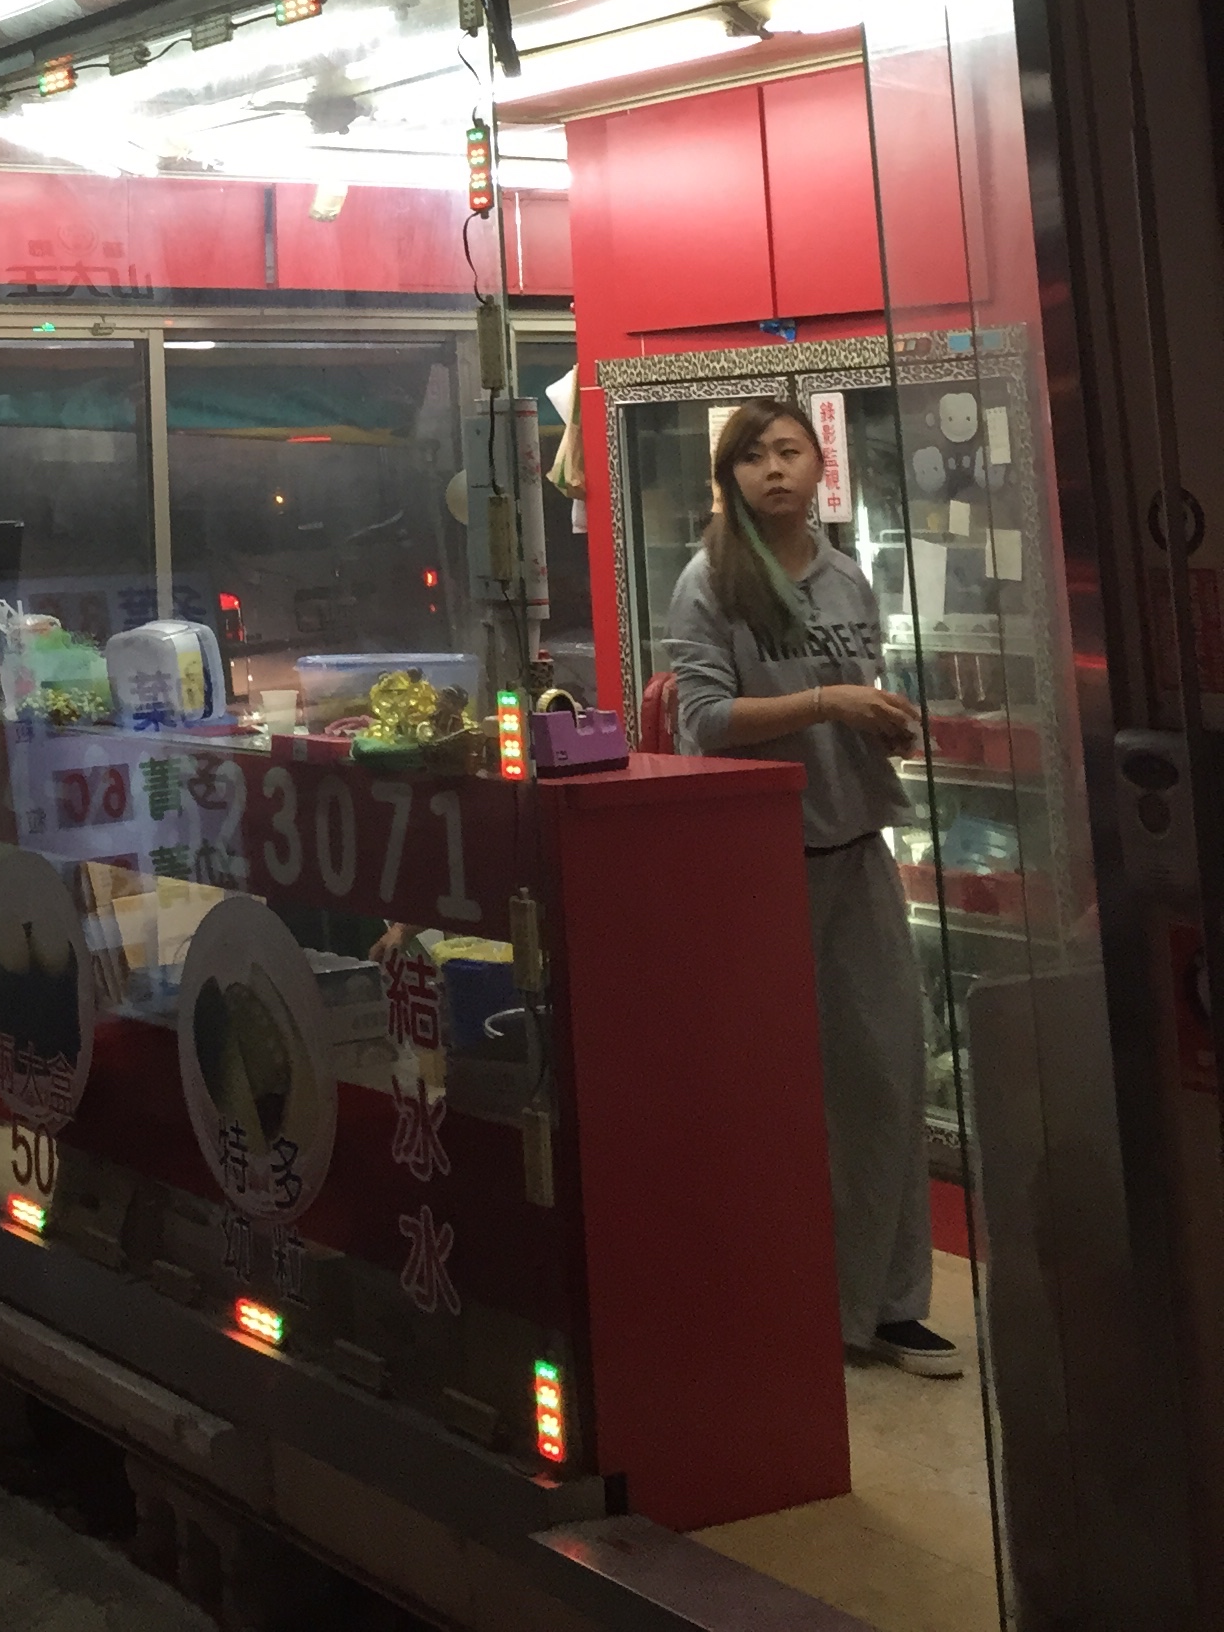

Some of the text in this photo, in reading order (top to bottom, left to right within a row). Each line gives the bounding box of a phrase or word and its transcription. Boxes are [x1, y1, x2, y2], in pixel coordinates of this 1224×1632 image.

[11, 1112, 55, 1196] 50
[385, 946, 462, 1317] 結冰水
